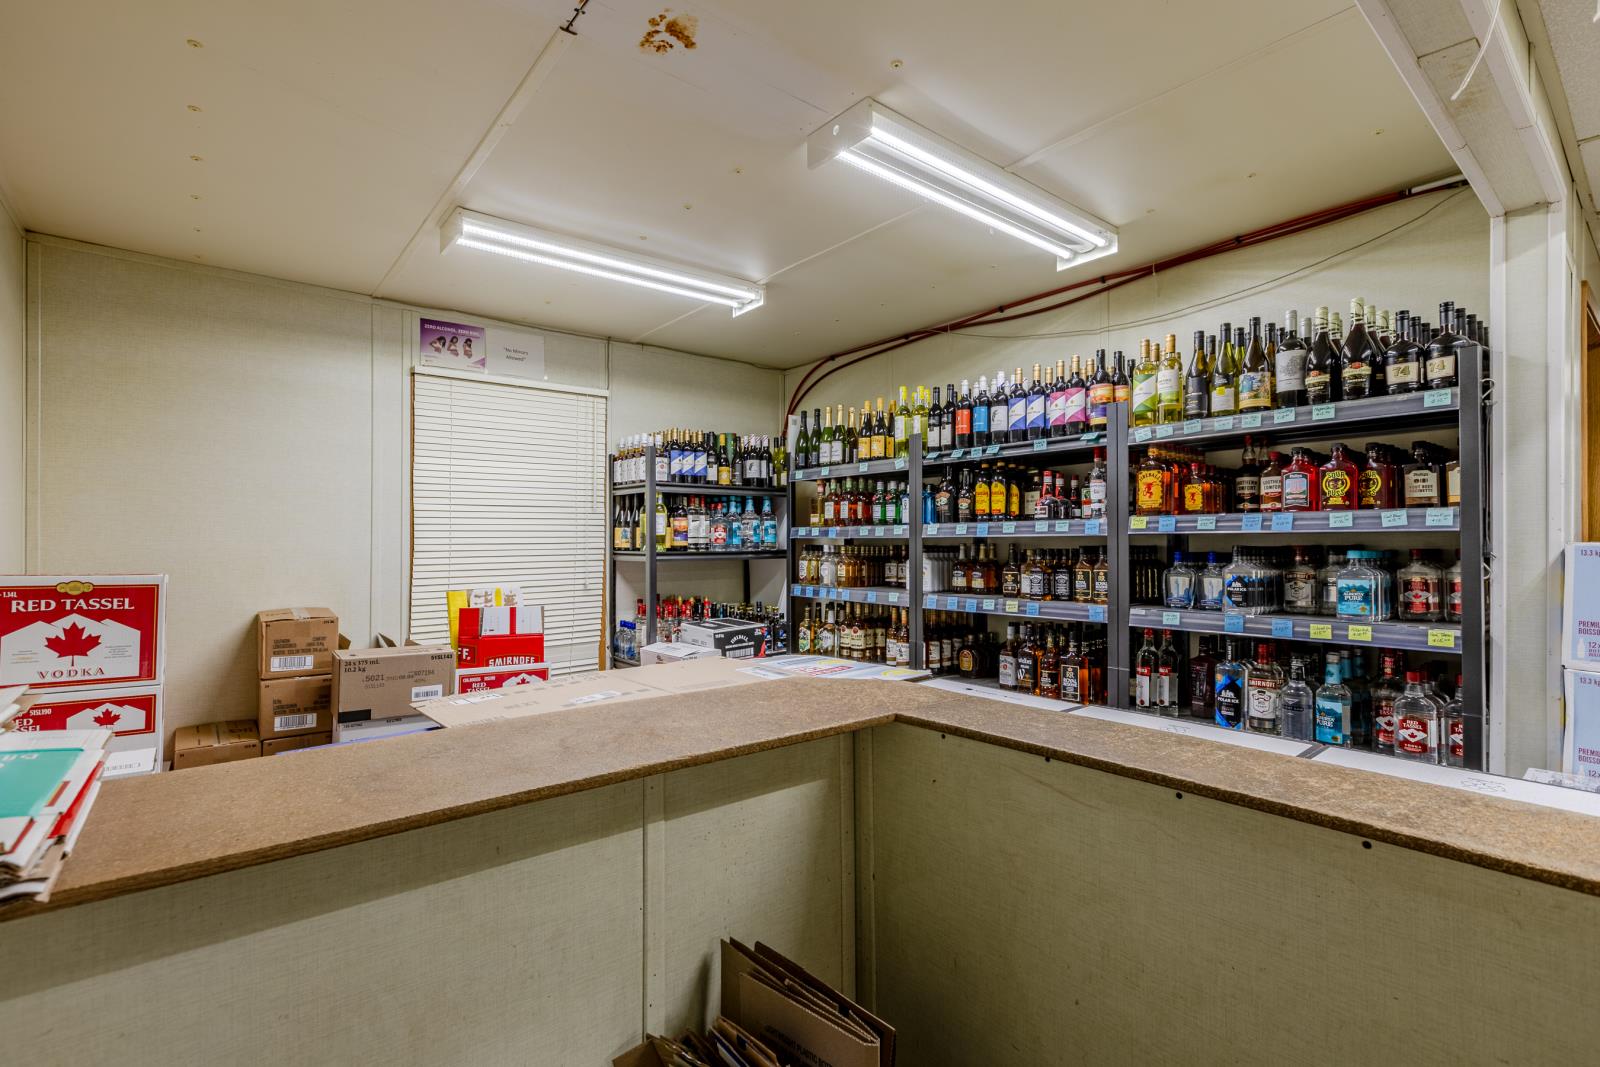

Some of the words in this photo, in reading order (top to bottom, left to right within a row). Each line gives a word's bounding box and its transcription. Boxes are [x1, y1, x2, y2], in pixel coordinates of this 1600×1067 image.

[1326, 471, 1346, 479] SOUR
[1326, 488, 1345, 497] PUSS
[11, 599, 56, 613] RED
[61, 597, 135, 611] TASSEL
[488, 656, 535, 668] SMIRNOFF
[37, 667, 105, 680] VODKA
[15, 718, 34, 727] ED
